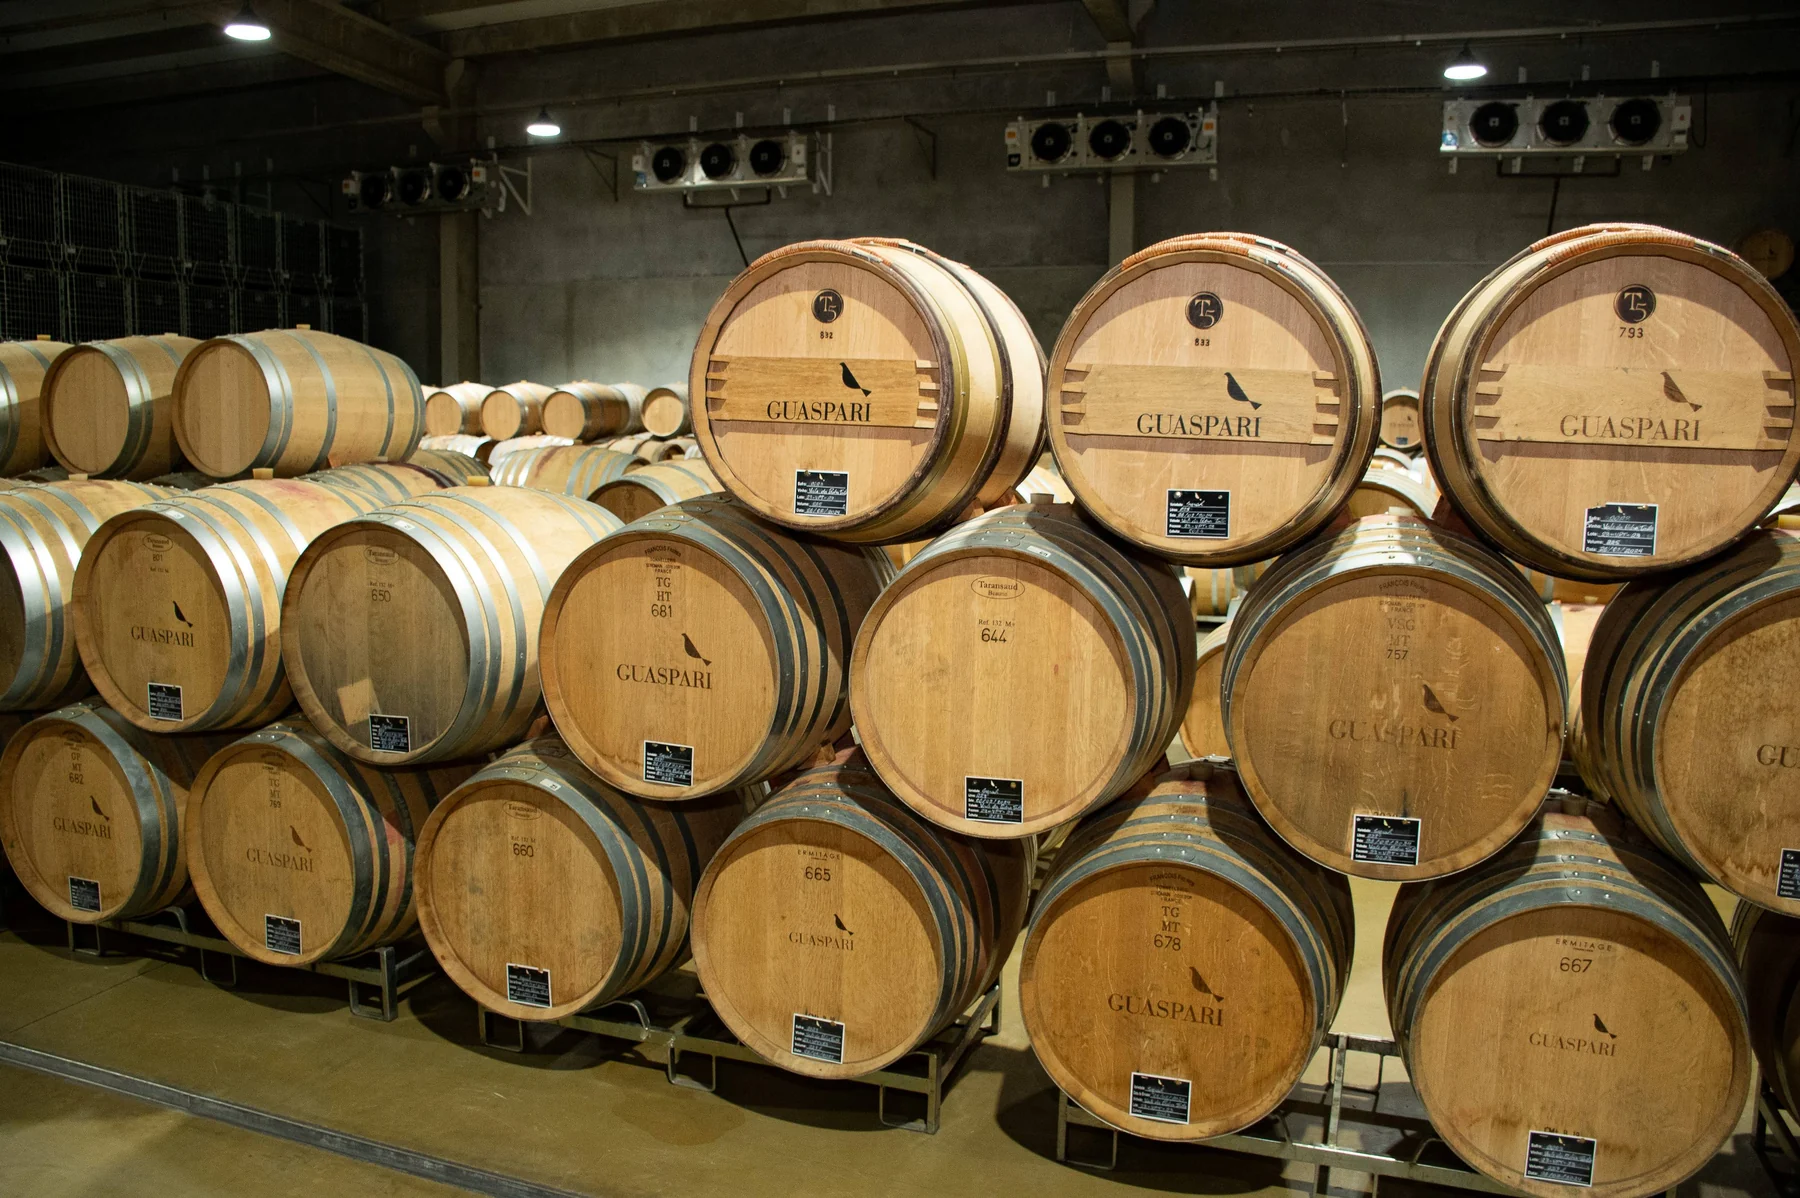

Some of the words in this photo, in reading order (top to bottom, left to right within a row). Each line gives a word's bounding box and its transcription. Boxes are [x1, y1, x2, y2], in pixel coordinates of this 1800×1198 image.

[820, 331, 833, 339] 832
[1619, 327, 1644, 338] 793
[1194, 338, 1210, 347] 833
[767, 400, 871, 422] GUASPARI
[1137, 413, 1262, 437] GUASPARI
[1560, 414, 1701, 441] GUASPARI
[655, 577, 672, 588] TG
[978, 581, 1018, 591] Taransaud
[371, 588, 392, 603] 650
[651, 604, 673, 617] 681
[131, 626, 194, 647] GUASPARI
[981, 627, 1007, 643] 644
[1387, 648, 1409, 660] 757
[616, 663, 712, 690] GUASPARI
[1329, 719, 1460, 750] GUASPARI
[53, 816, 111, 839] GUASPARI
[513, 843, 534, 857] 660
[797, 849, 840, 860] ERMITAGE
[246, 847, 314, 873] GUASPARI
[805, 866, 831, 881] 665
[1161, 905, 1181, 918] TG
[1161, 920, 1181, 933] MT
[788, 931, 854, 951] GUASPARI
[1153, 934, 1182, 951] 678
[1556, 938, 1612, 951] ERMITAGE
[1560, 957, 1592, 973] 667
[1107, 993, 1223, 1027] GUASPARI
[1529, 1031, 1617, 1057] GUASPARI
